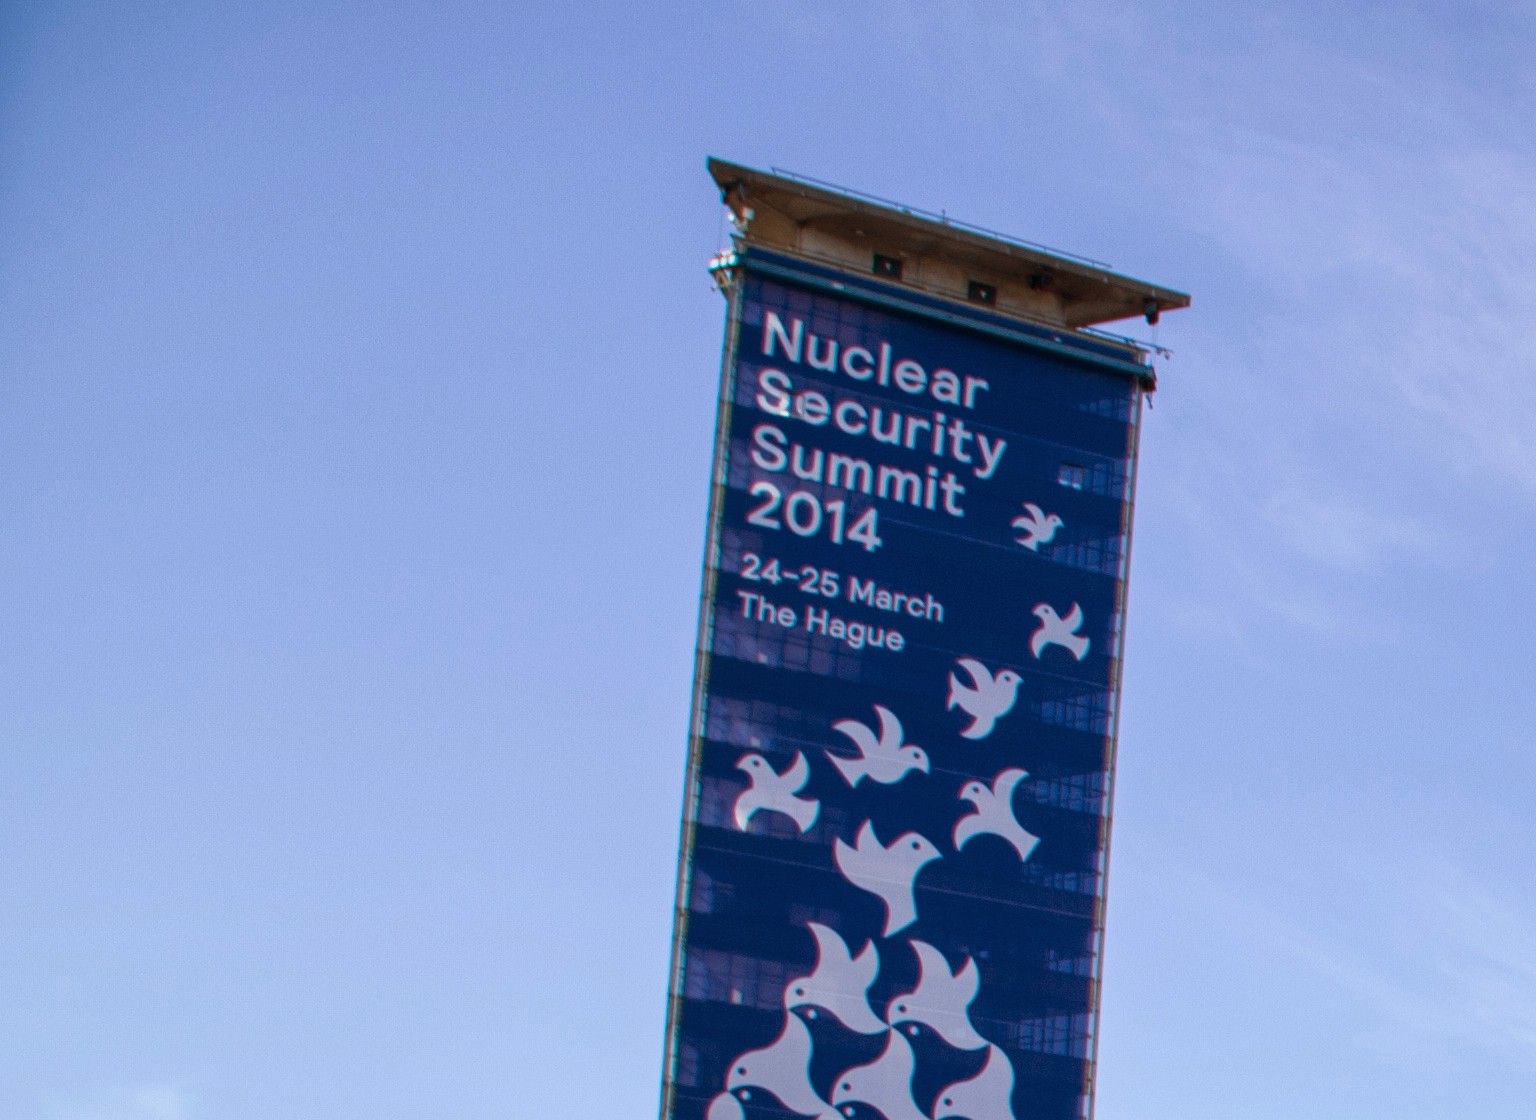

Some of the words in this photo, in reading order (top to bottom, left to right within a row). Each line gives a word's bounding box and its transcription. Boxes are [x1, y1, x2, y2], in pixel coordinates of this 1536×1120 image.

[761, 310, 990, 410] Nuclear
[756, 367, 1007, 480] Security
[751, 423, 966, 518] Summit
[746, 481, 882, 552] 2014
[737, 589, 797, 628] The
[805, 605, 906, 651] Hague
[740, 552, 840, 598] 24-25
[849, 576, 944, 623] March
